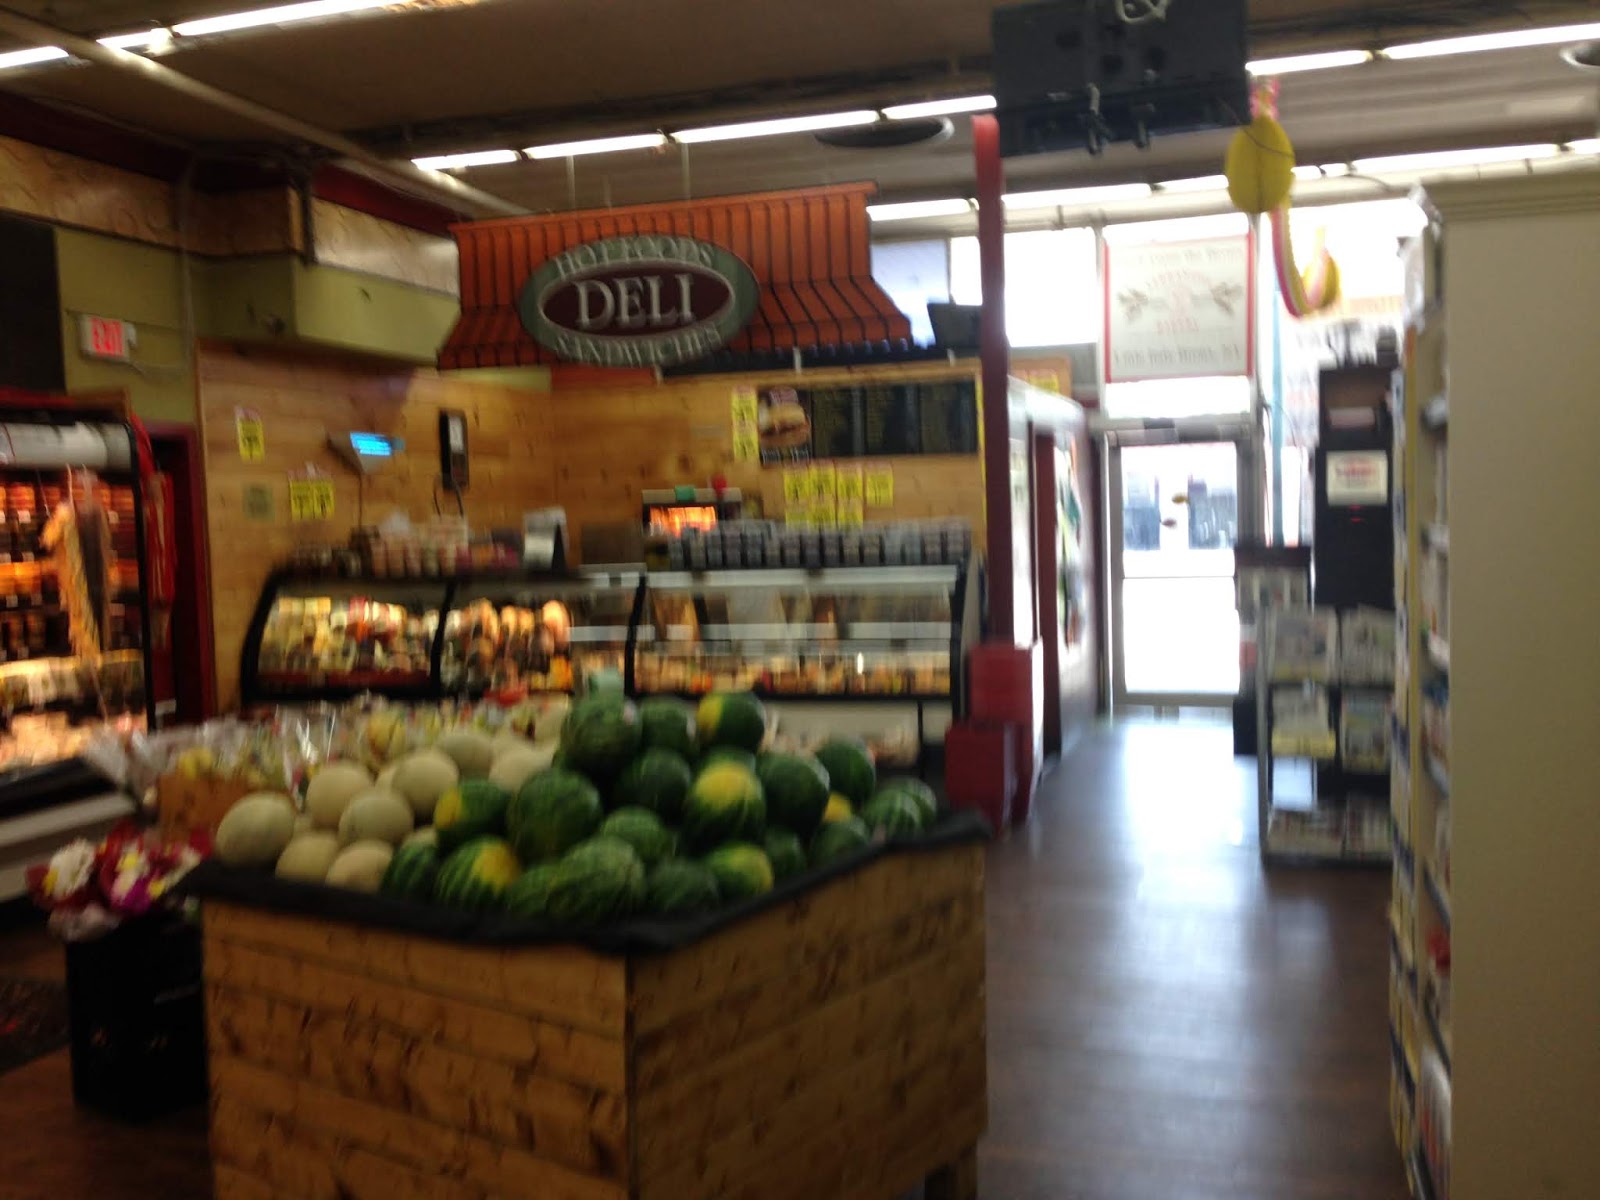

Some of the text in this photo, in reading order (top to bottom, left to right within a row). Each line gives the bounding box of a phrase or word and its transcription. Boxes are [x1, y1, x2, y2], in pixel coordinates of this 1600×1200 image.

[555, 235, 715, 278] HOT FOODS
[574, 272, 694, 333] DELI
[91, 317, 123, 356] EXIT
